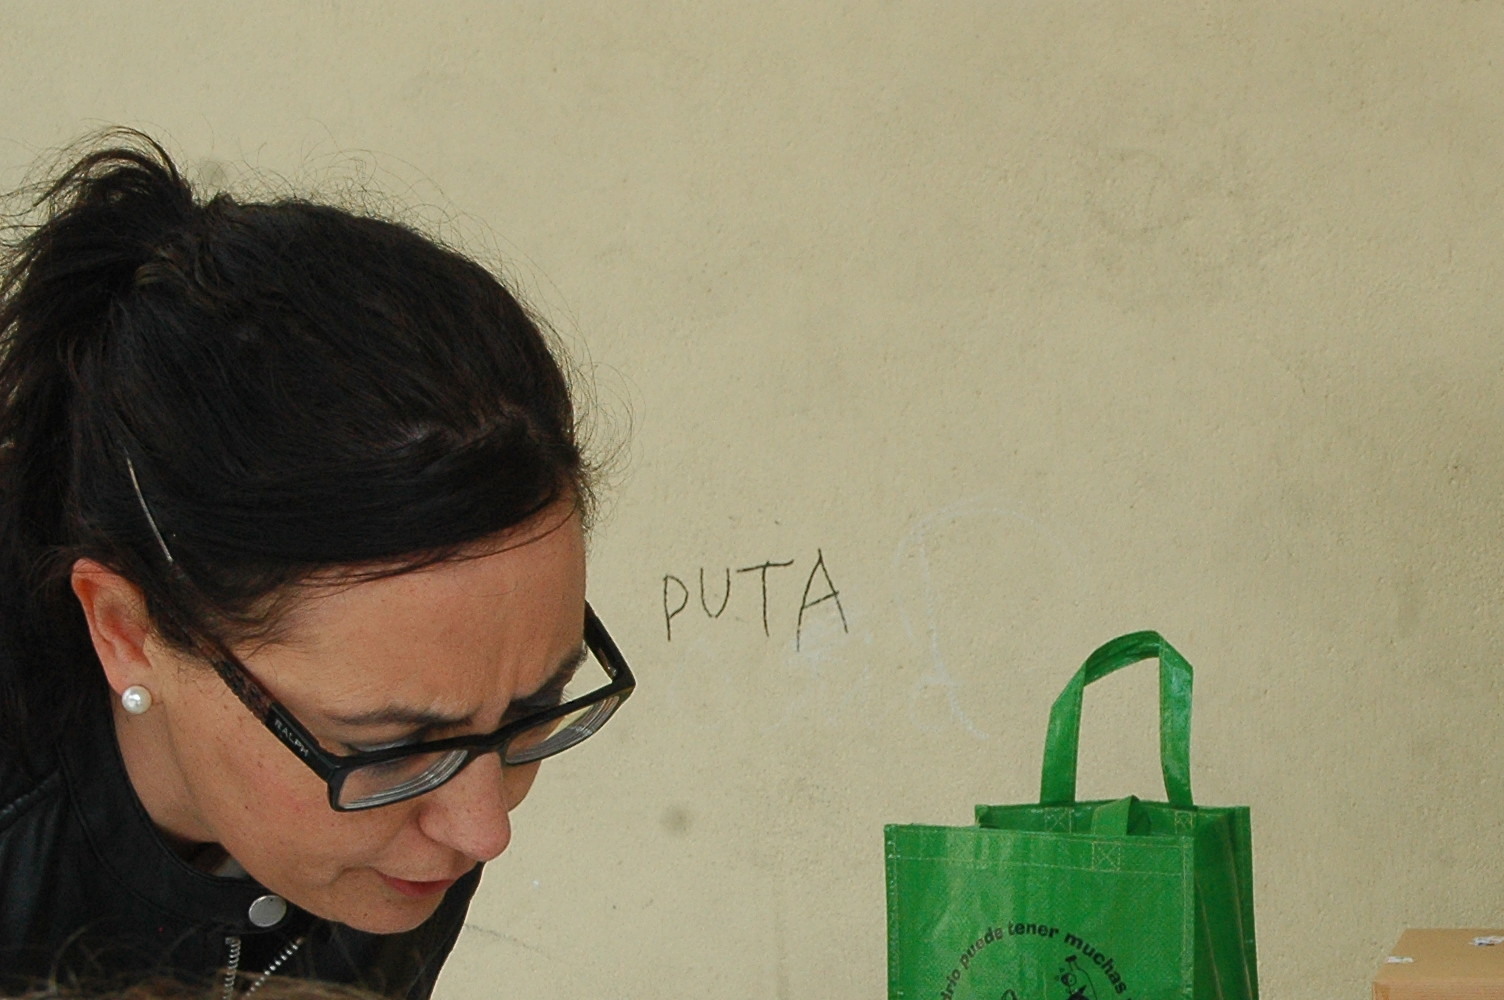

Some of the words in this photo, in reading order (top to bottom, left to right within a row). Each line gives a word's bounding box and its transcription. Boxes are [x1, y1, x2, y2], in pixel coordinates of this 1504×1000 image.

[662, 547, 849, 652] PUTA
[274, 718, 309, 758] RALPH
[960, 926, 1003, 970] puede
[1008, 920, 1059, 938] tener
[1064, 932, 1127, 994] muchas
